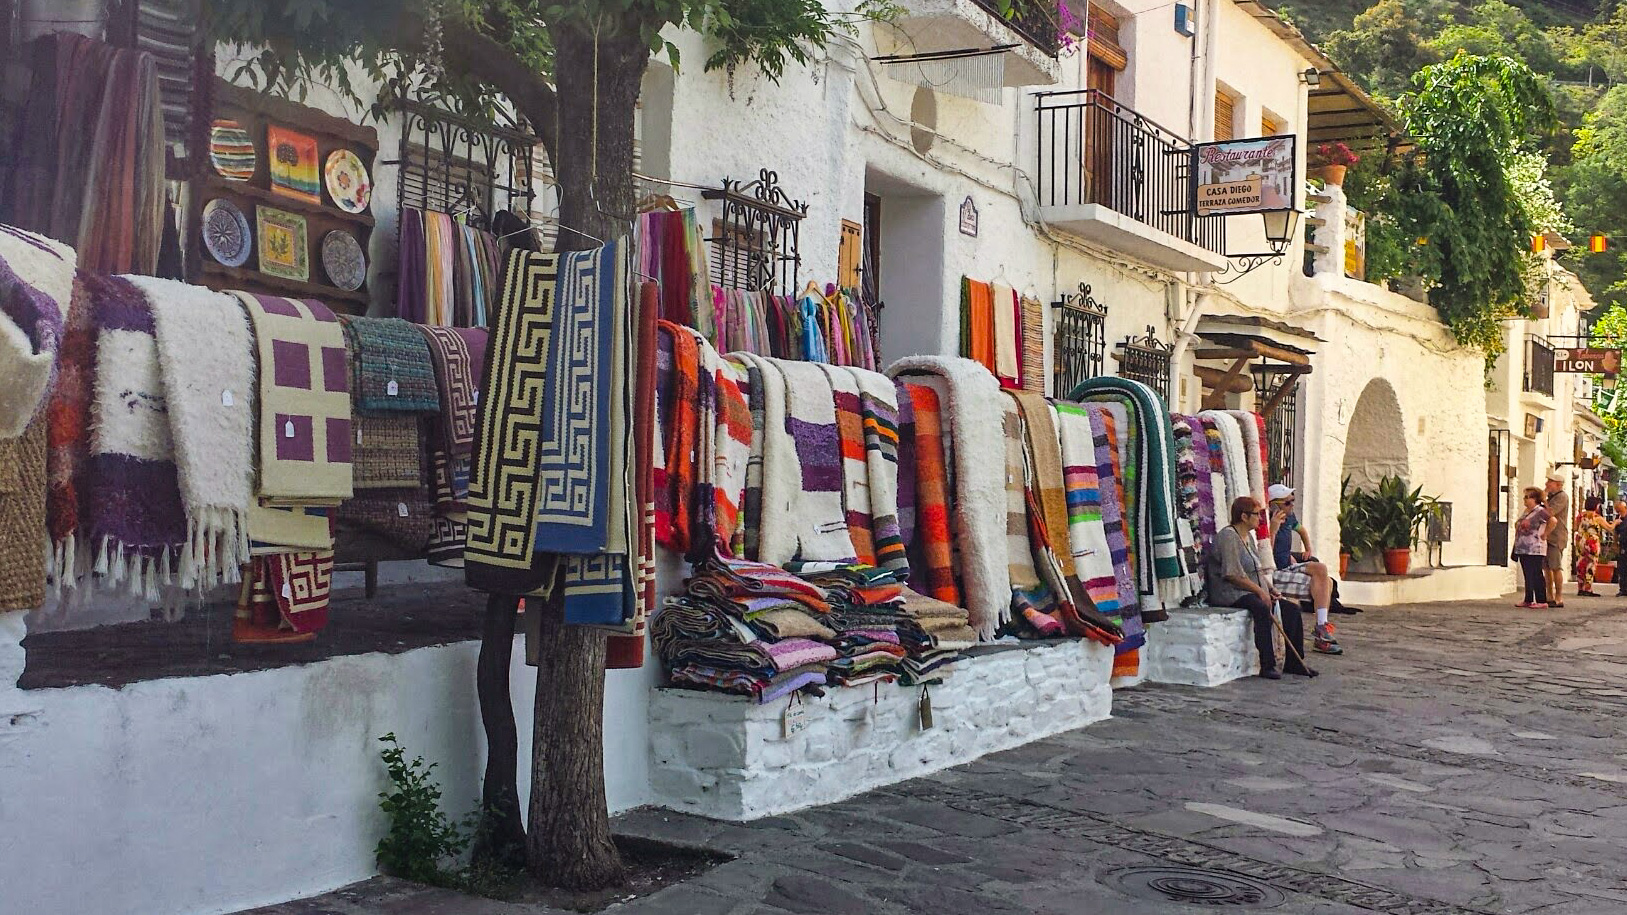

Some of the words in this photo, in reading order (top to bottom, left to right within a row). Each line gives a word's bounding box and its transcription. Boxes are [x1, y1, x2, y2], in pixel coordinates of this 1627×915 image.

[1200, 145, 1275, 164] Restaurante
[1206, 187, 1228, 197] CASA
[1230, 184, 1252, 194] DIEGO
[1199, 197, 1226, 207] TERRAZA
[1228, 195, 1260, 206] COMEDOR
